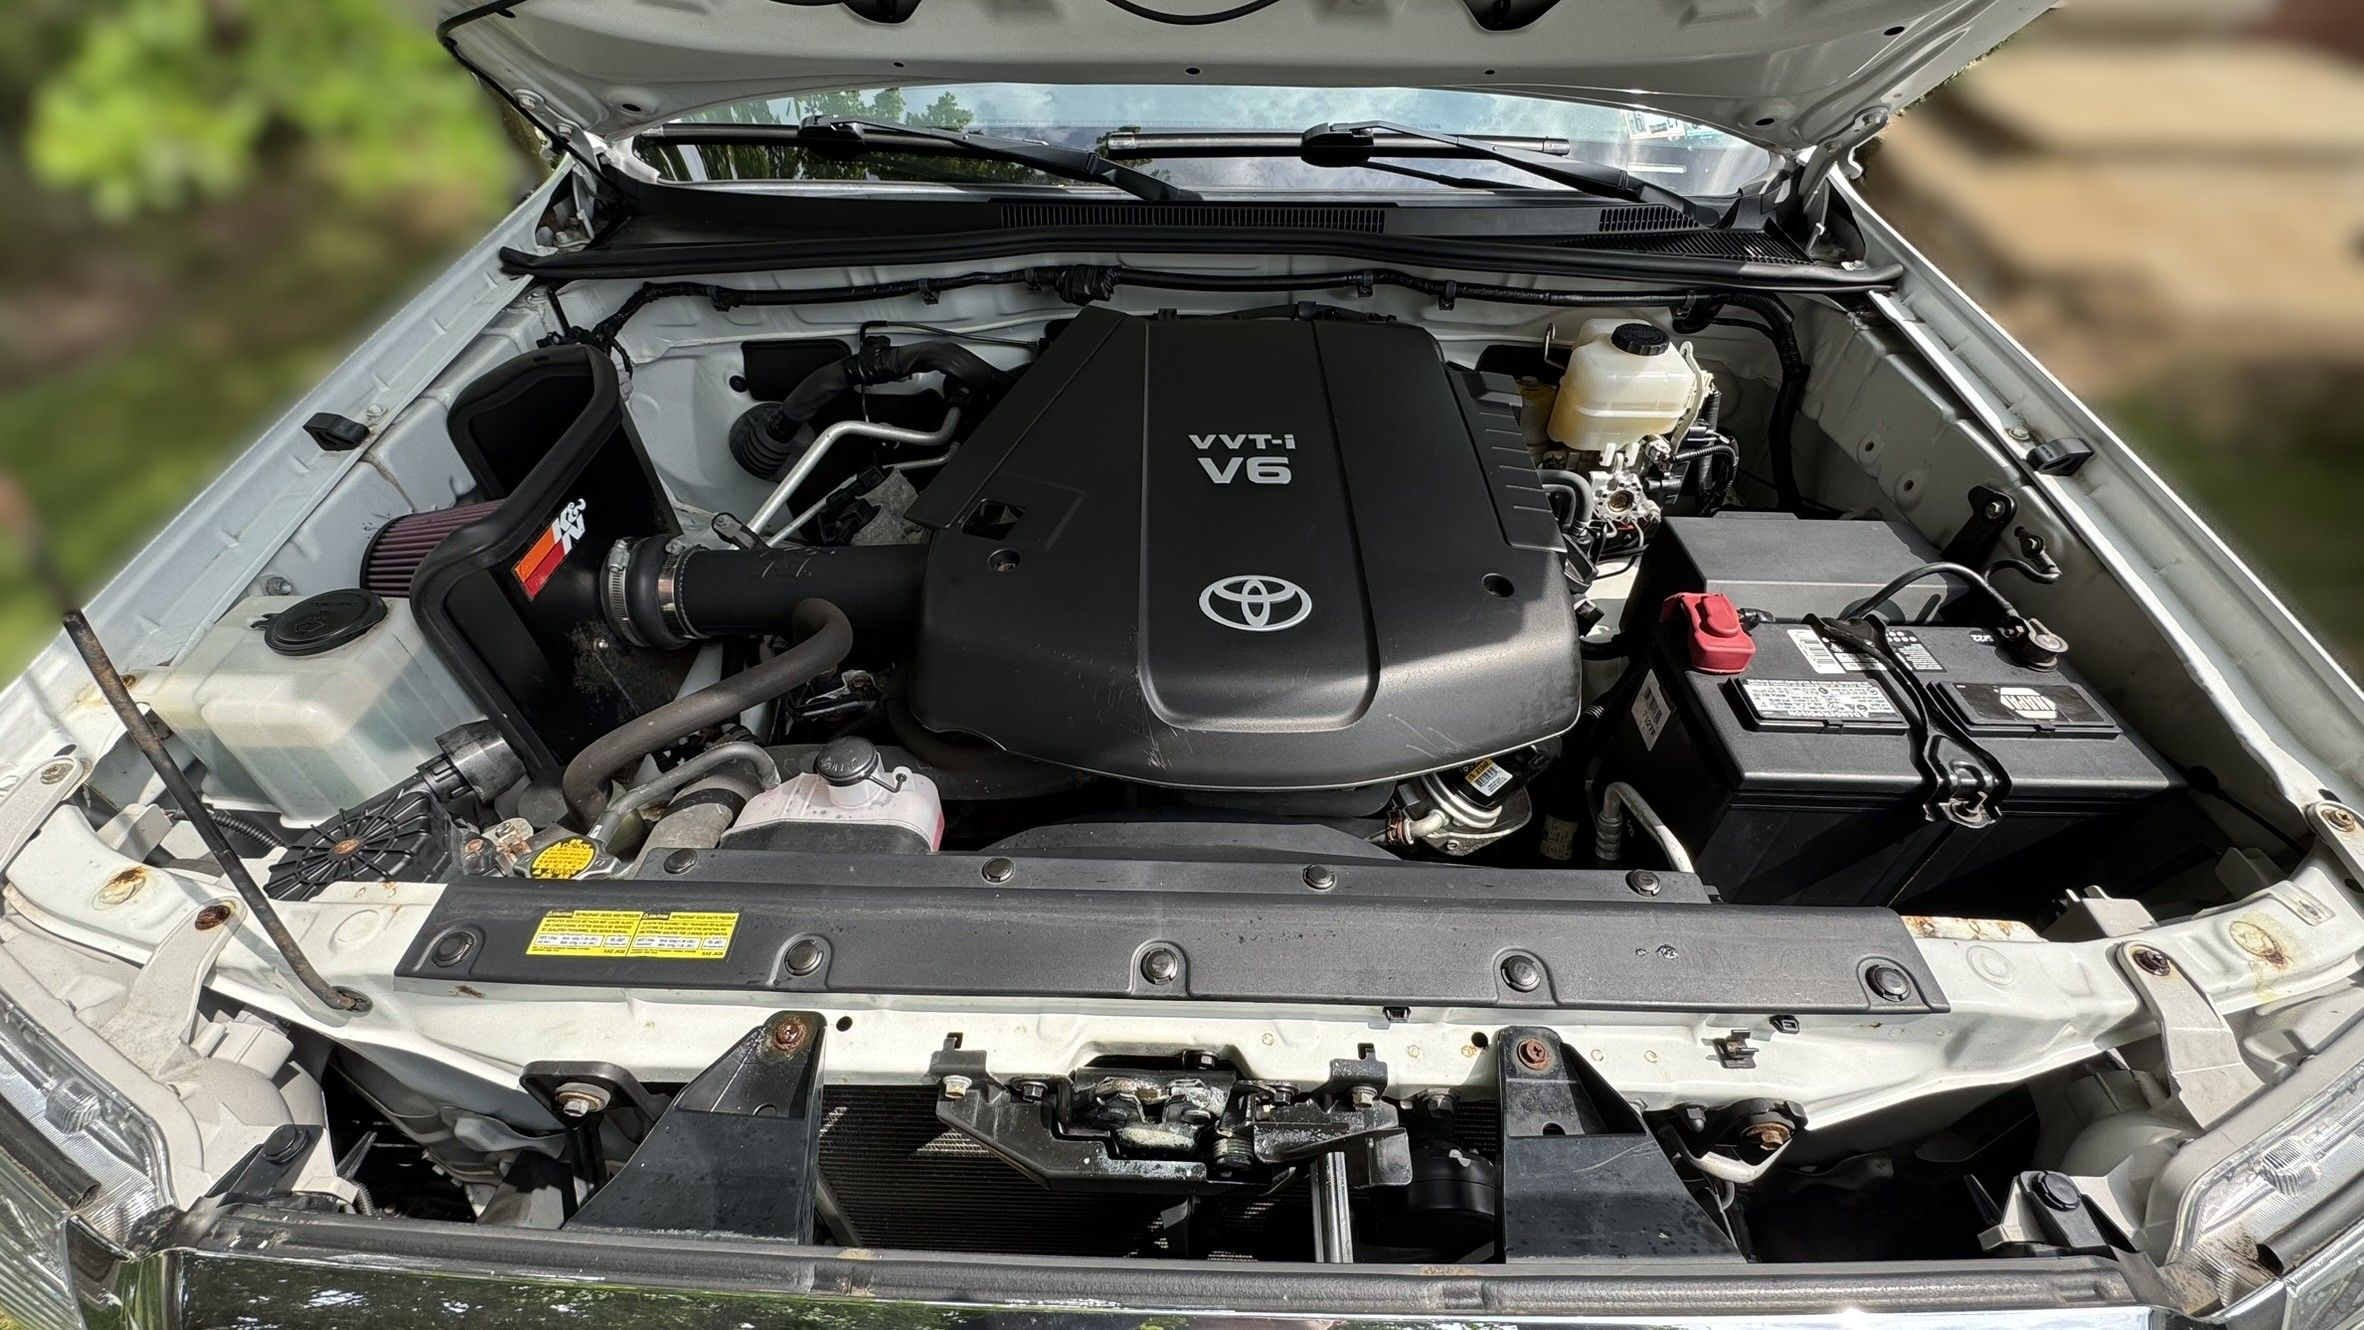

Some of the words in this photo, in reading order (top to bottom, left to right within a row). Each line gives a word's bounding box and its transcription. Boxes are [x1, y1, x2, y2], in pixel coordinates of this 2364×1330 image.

[1188, 434, 1296, 449] VVT-i
[1197, 456, 1292, 484] V6
[552, 498, 586, 555] K&N
